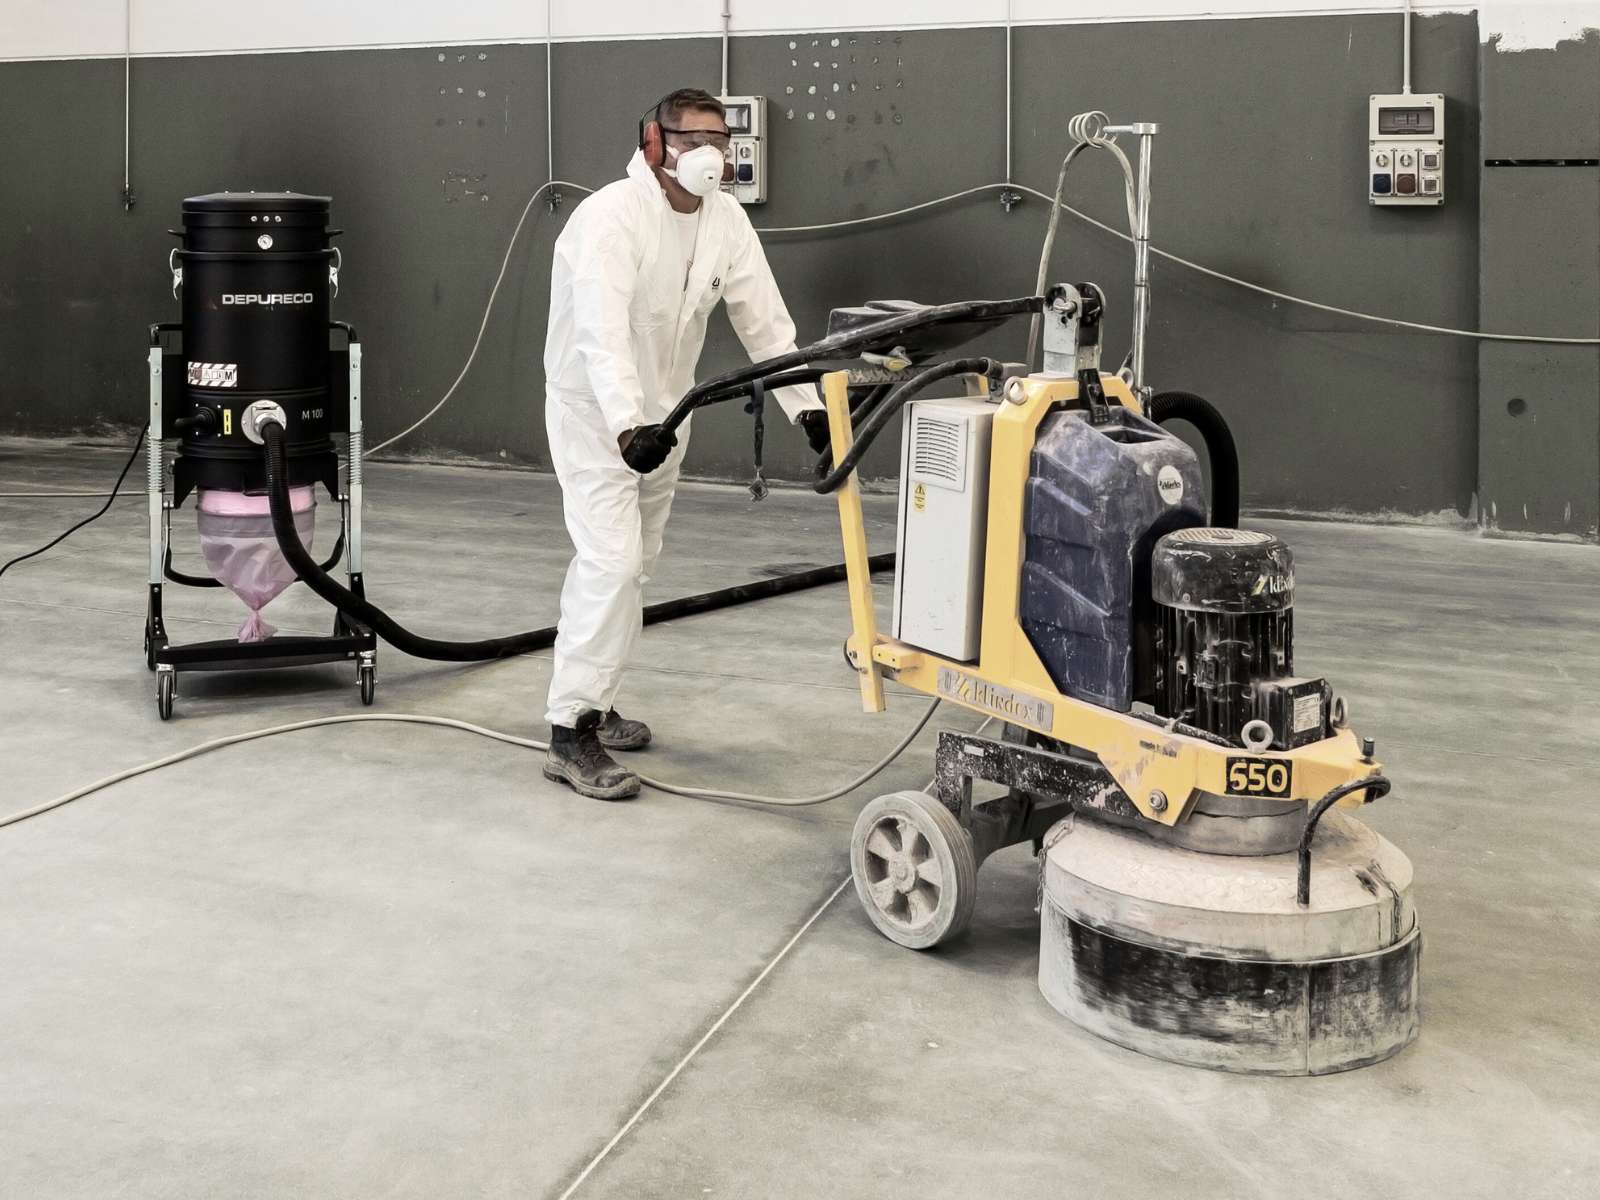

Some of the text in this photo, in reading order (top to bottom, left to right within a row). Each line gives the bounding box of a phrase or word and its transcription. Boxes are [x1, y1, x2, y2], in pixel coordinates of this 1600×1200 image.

[222, 293, 313, 305] DEPURECO
[302, 408, 324, 420] M 100
